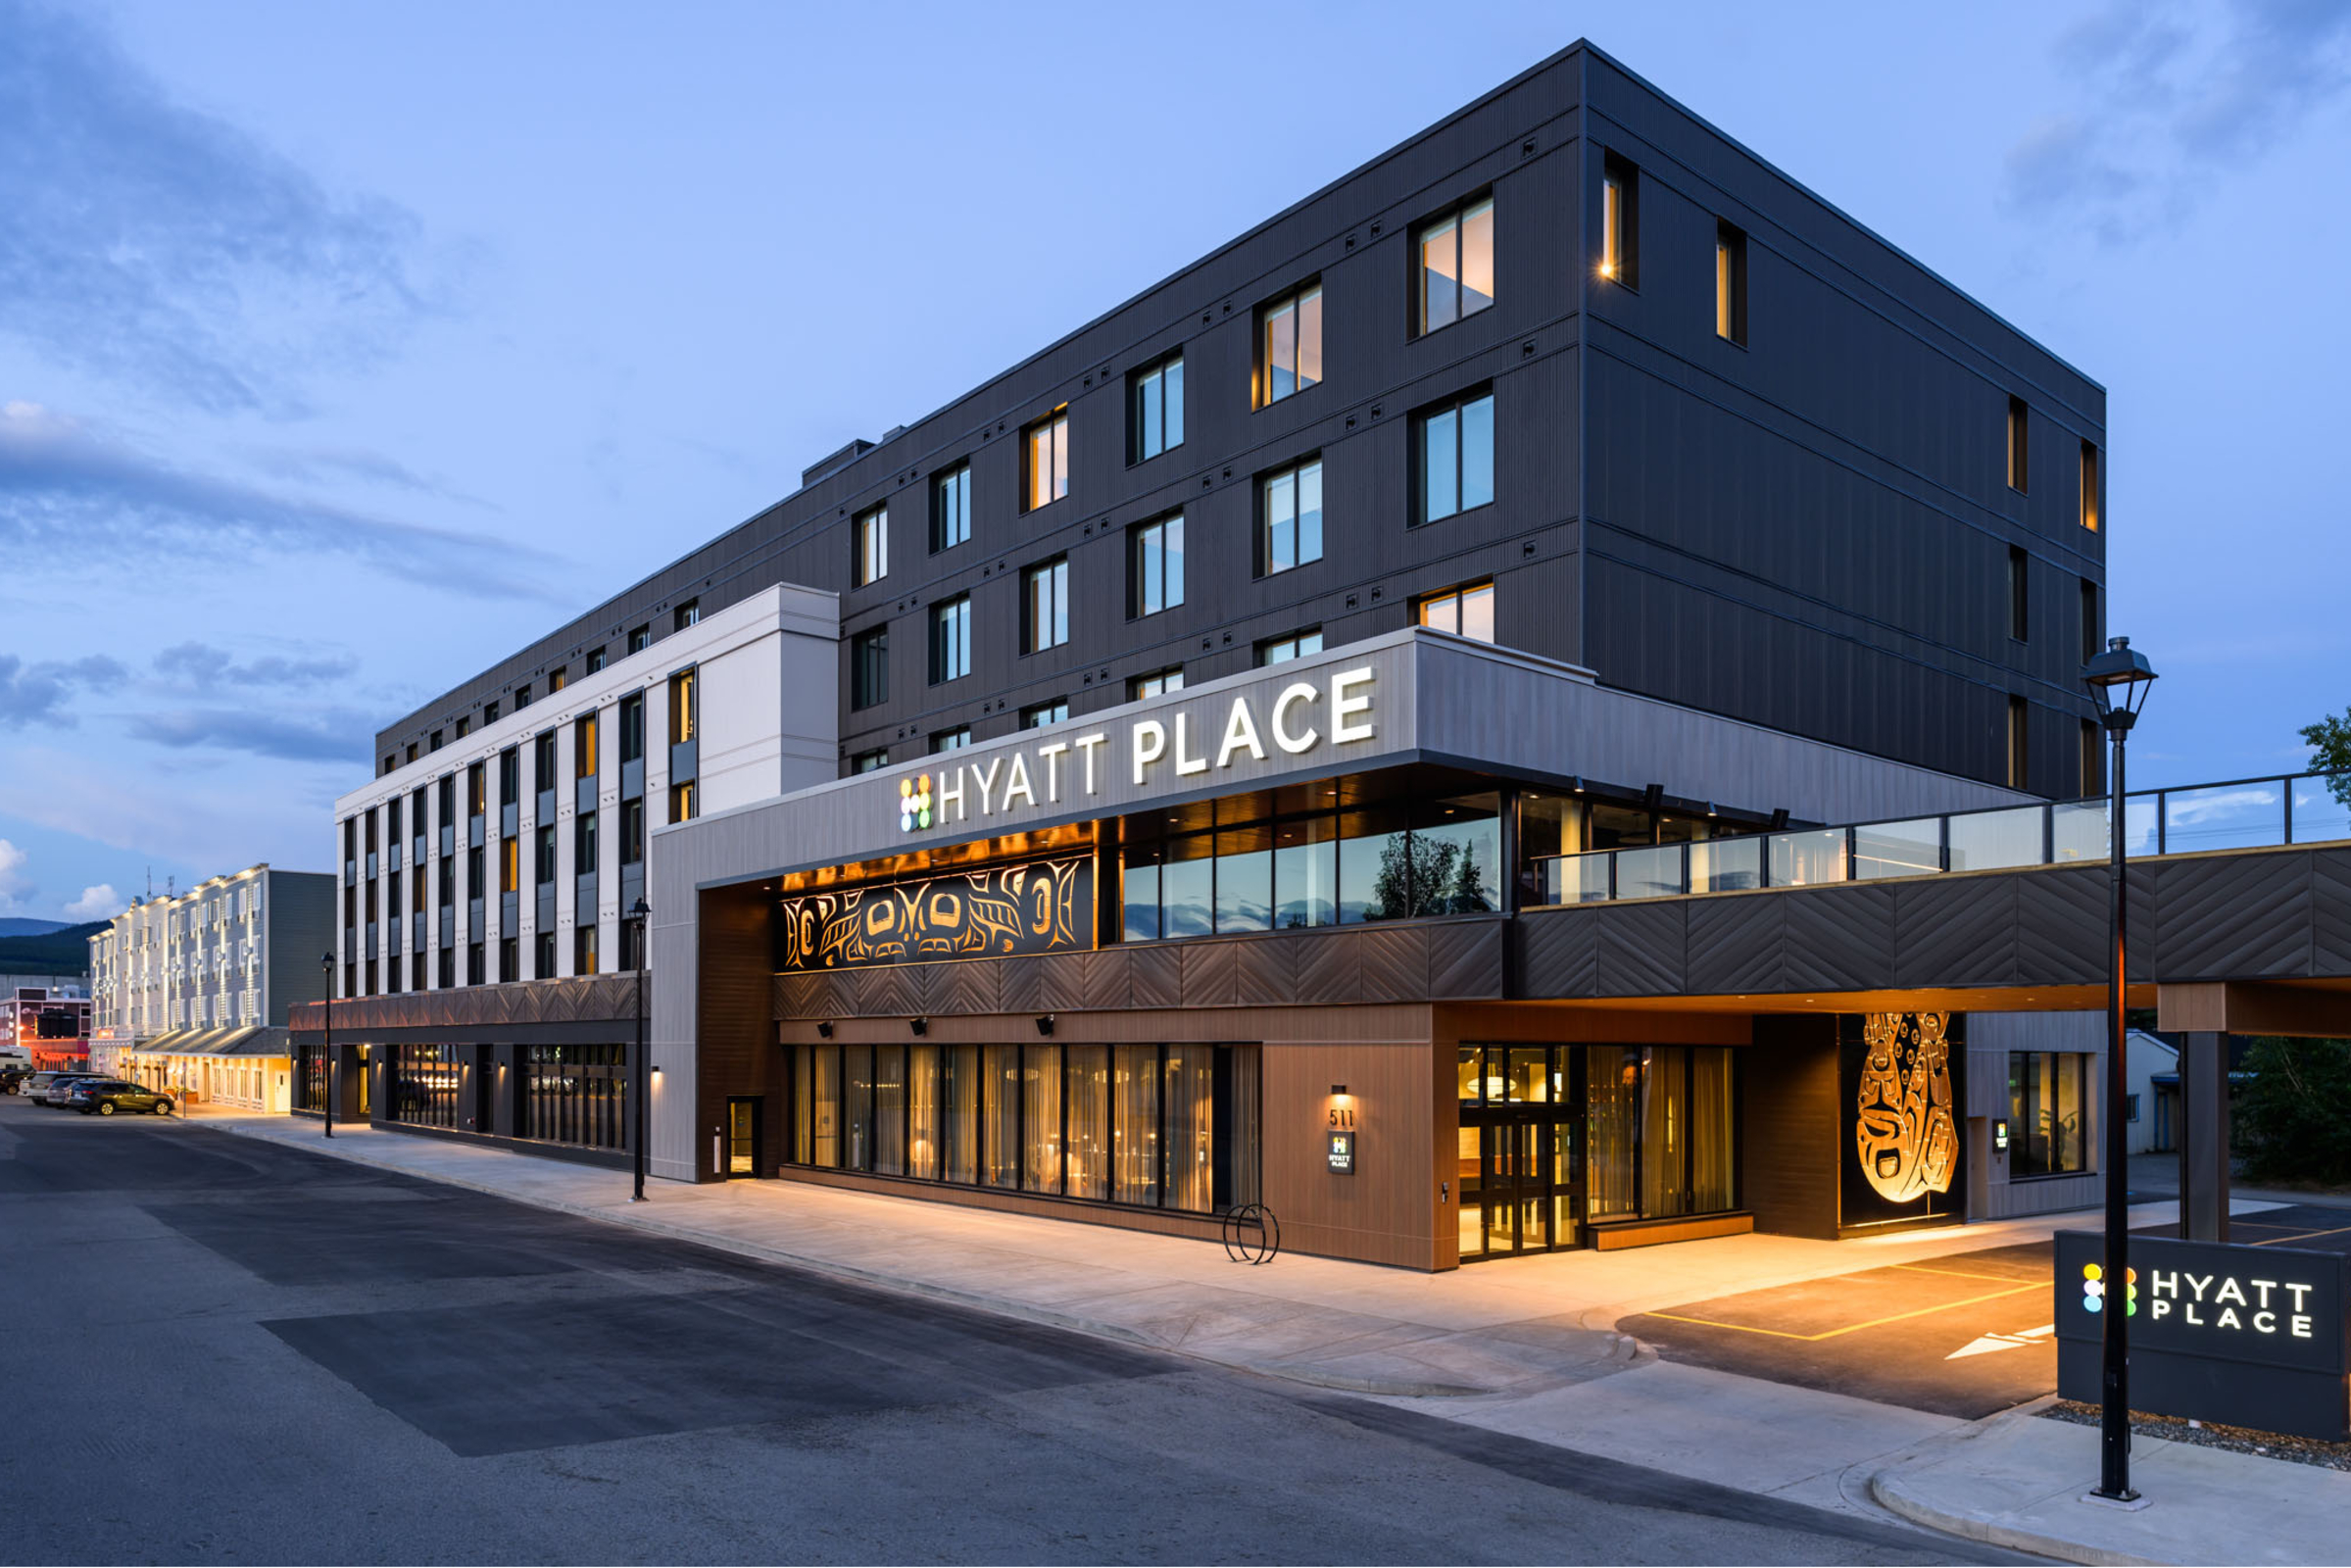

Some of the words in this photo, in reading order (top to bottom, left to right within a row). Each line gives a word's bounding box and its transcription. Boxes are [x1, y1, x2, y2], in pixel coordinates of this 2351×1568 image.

[939, 733, 1108, 824] HYATT
[1133, 666, 1375, 784] PLACE
[1330, 1108, 1353, 1126] 511
[2152, 1269, 2313, 1312] HYATT
[2152, 1299, 2313, 1338] PLACE
